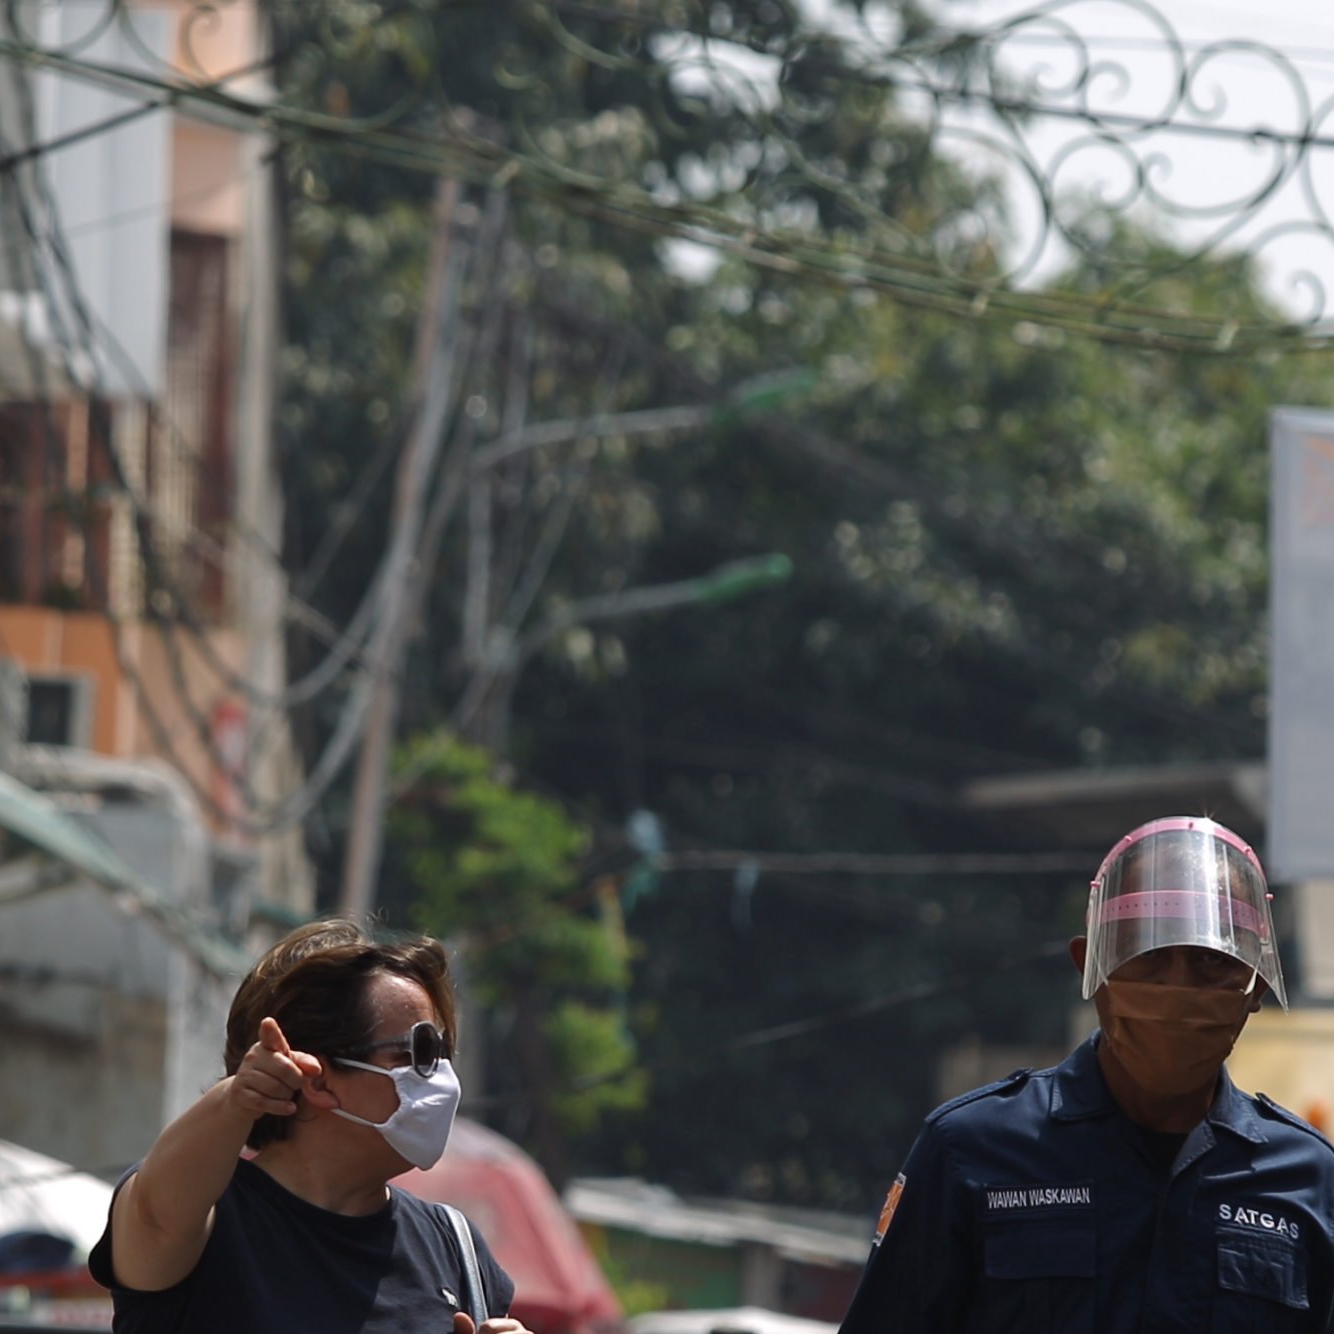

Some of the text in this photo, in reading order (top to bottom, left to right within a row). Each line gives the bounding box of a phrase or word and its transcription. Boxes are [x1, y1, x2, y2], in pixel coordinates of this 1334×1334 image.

[987, 1187, 1090, 1209] WAWAN WASKAWAN
[1219, 1203, 1299, 1239] SATGAS
